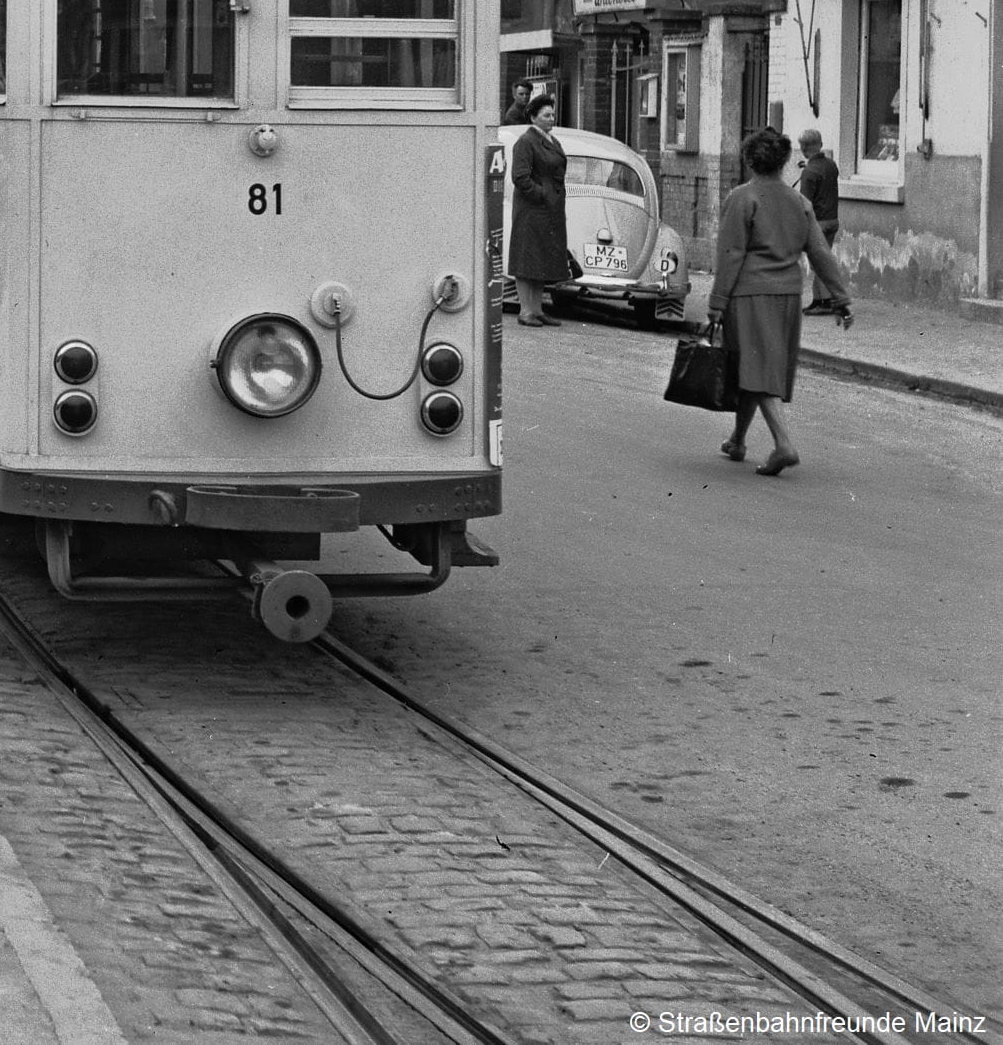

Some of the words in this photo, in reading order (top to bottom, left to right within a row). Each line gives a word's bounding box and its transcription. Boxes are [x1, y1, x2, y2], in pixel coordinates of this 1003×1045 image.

[248, 183, 282, 215] 81
[596, 246, 615, 257] MZ
[585, 256, 603, 266] CP
[605, 257, 627, 269] 796
[660, 260, 669, 271] D
